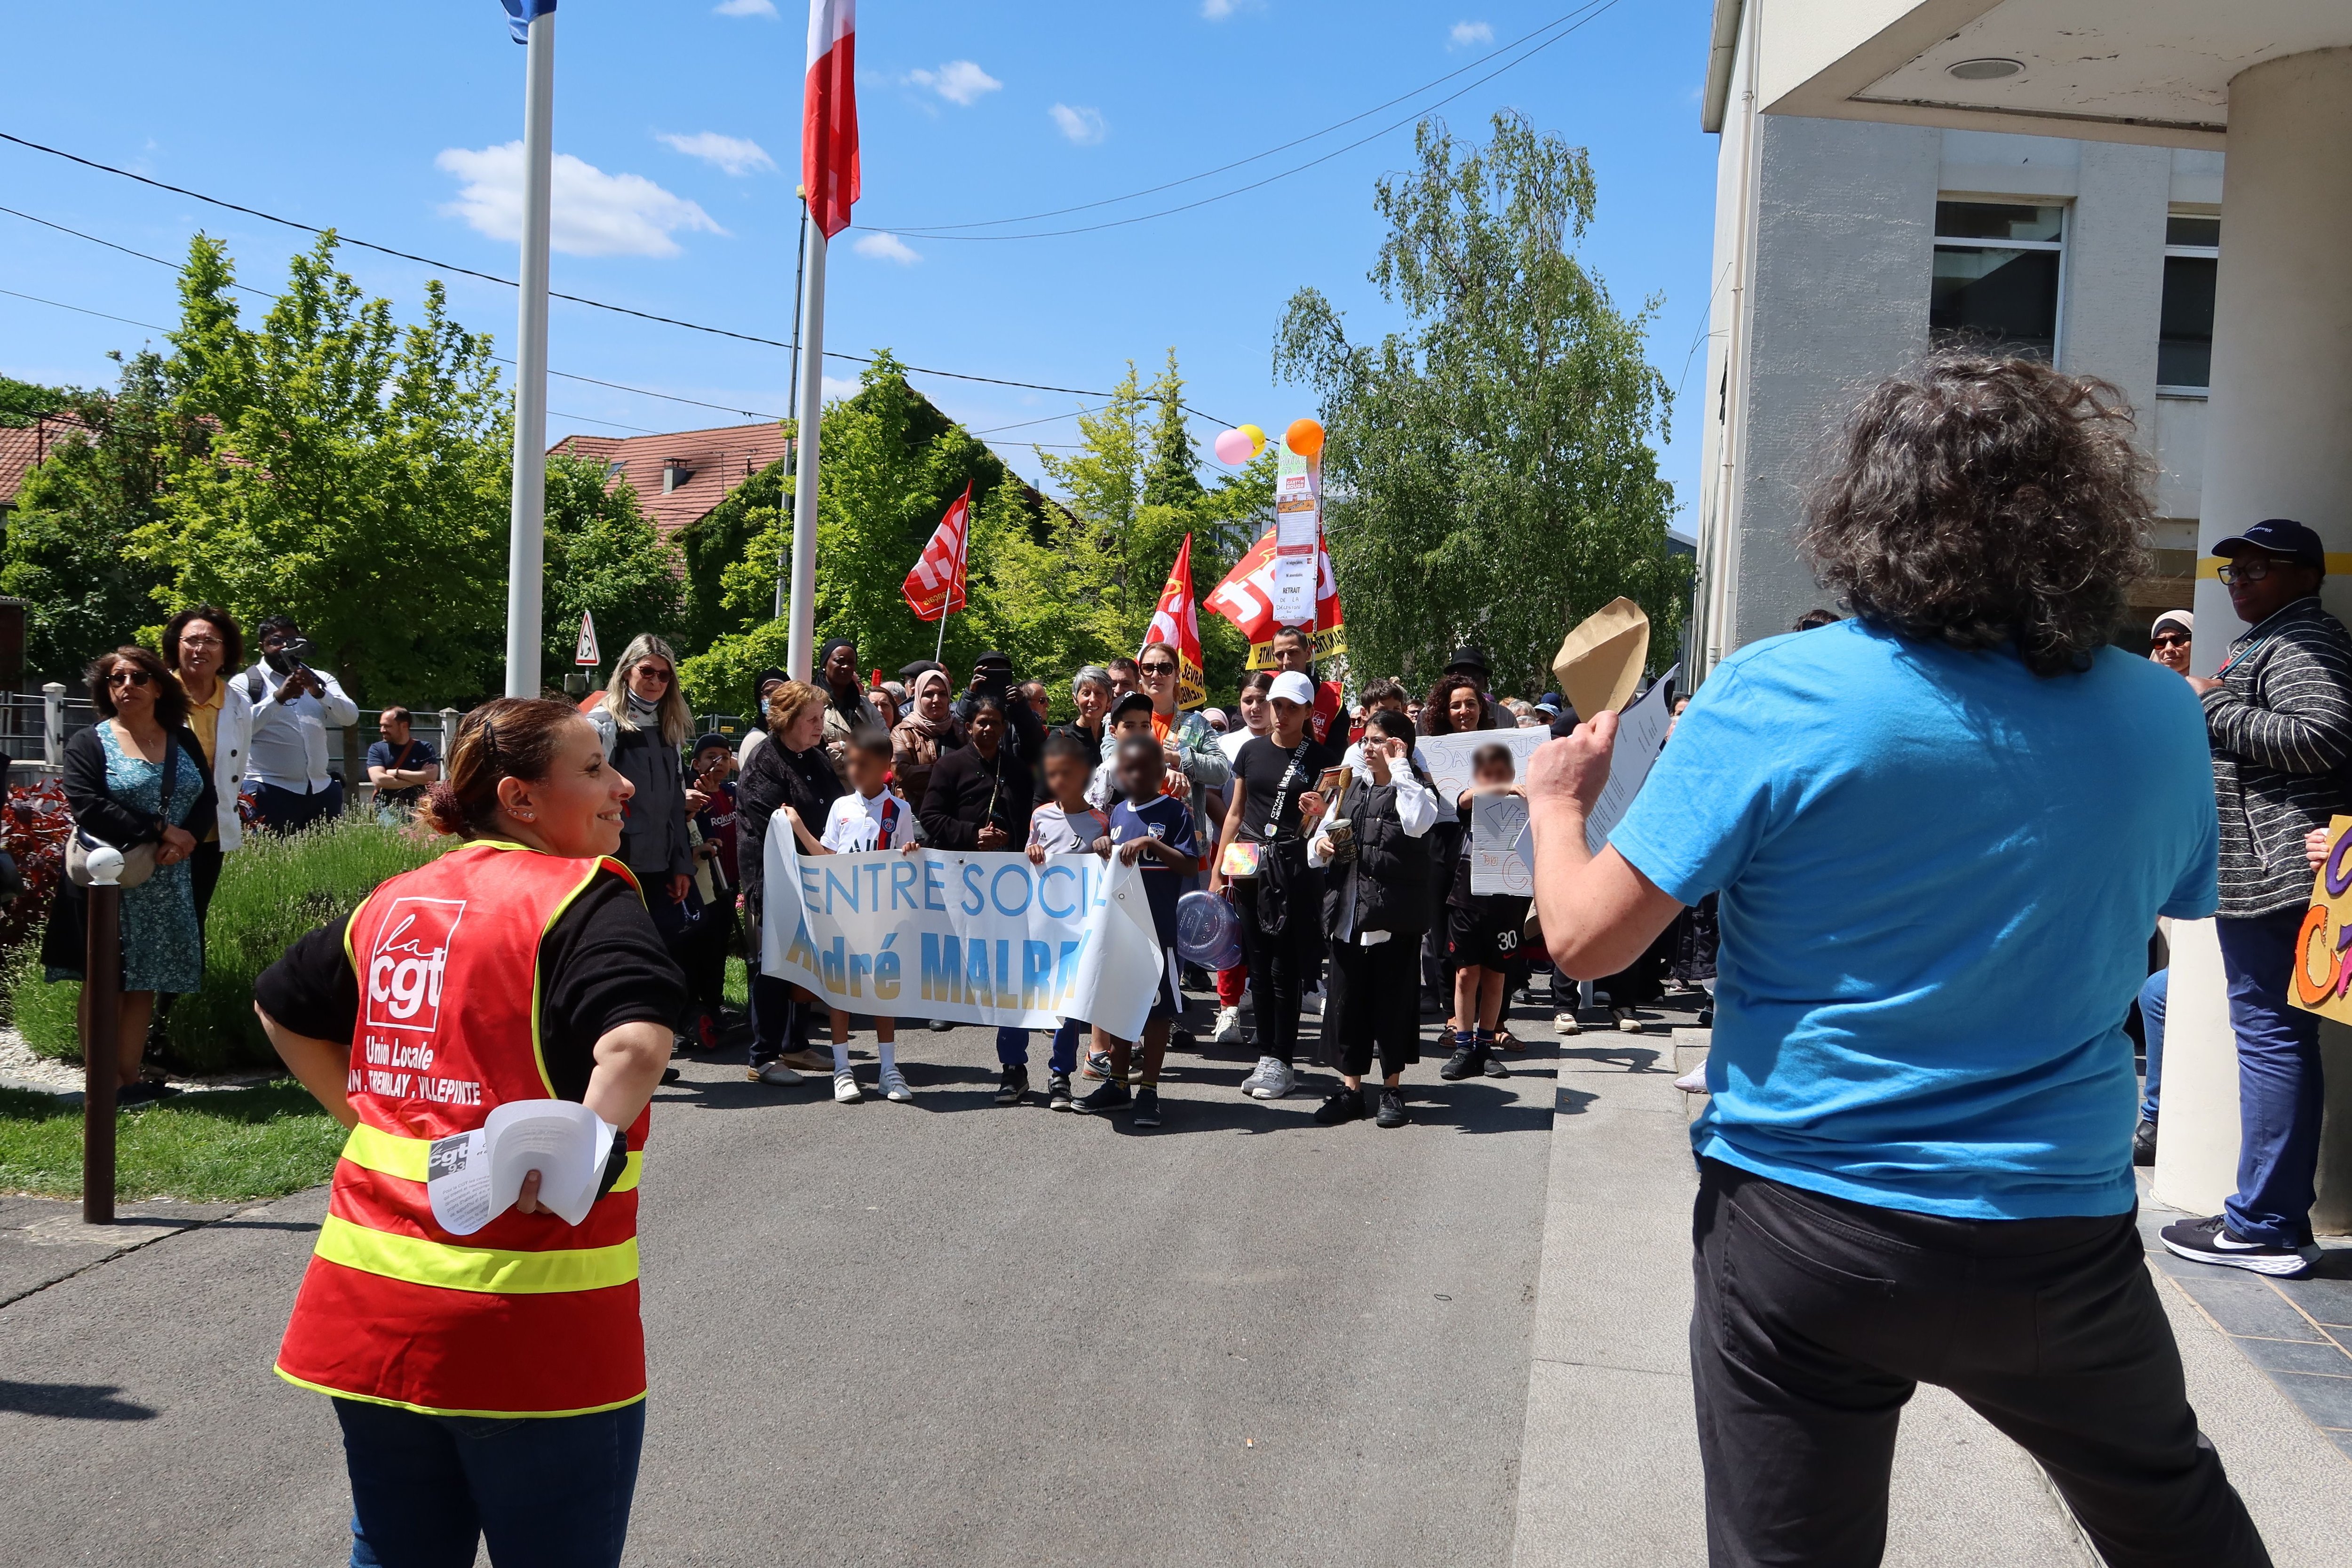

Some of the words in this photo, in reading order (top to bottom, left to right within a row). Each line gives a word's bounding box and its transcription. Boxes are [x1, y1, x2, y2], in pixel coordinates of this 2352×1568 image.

[1182, 663, 1204, 689] SEVRA
[799, 860, 946, 915] ENTRE
[377, 914, 445, 957] la
[1497, 930, 1518, 950] 30
[370, 947, 445, 1019] cgt
[921, 930, 1092, 1011] MALRA
[366, 1035, 389, 1066] Union
[391, 1038, 434, 1070] Locale
[368, 1069, 411, 1098] TREMBLAY
[417, 1075, 482, 1106] VILLEPINTE
[429, 1142, 469, 1167] cgt
[448, 1161, 466, 1174] 93
